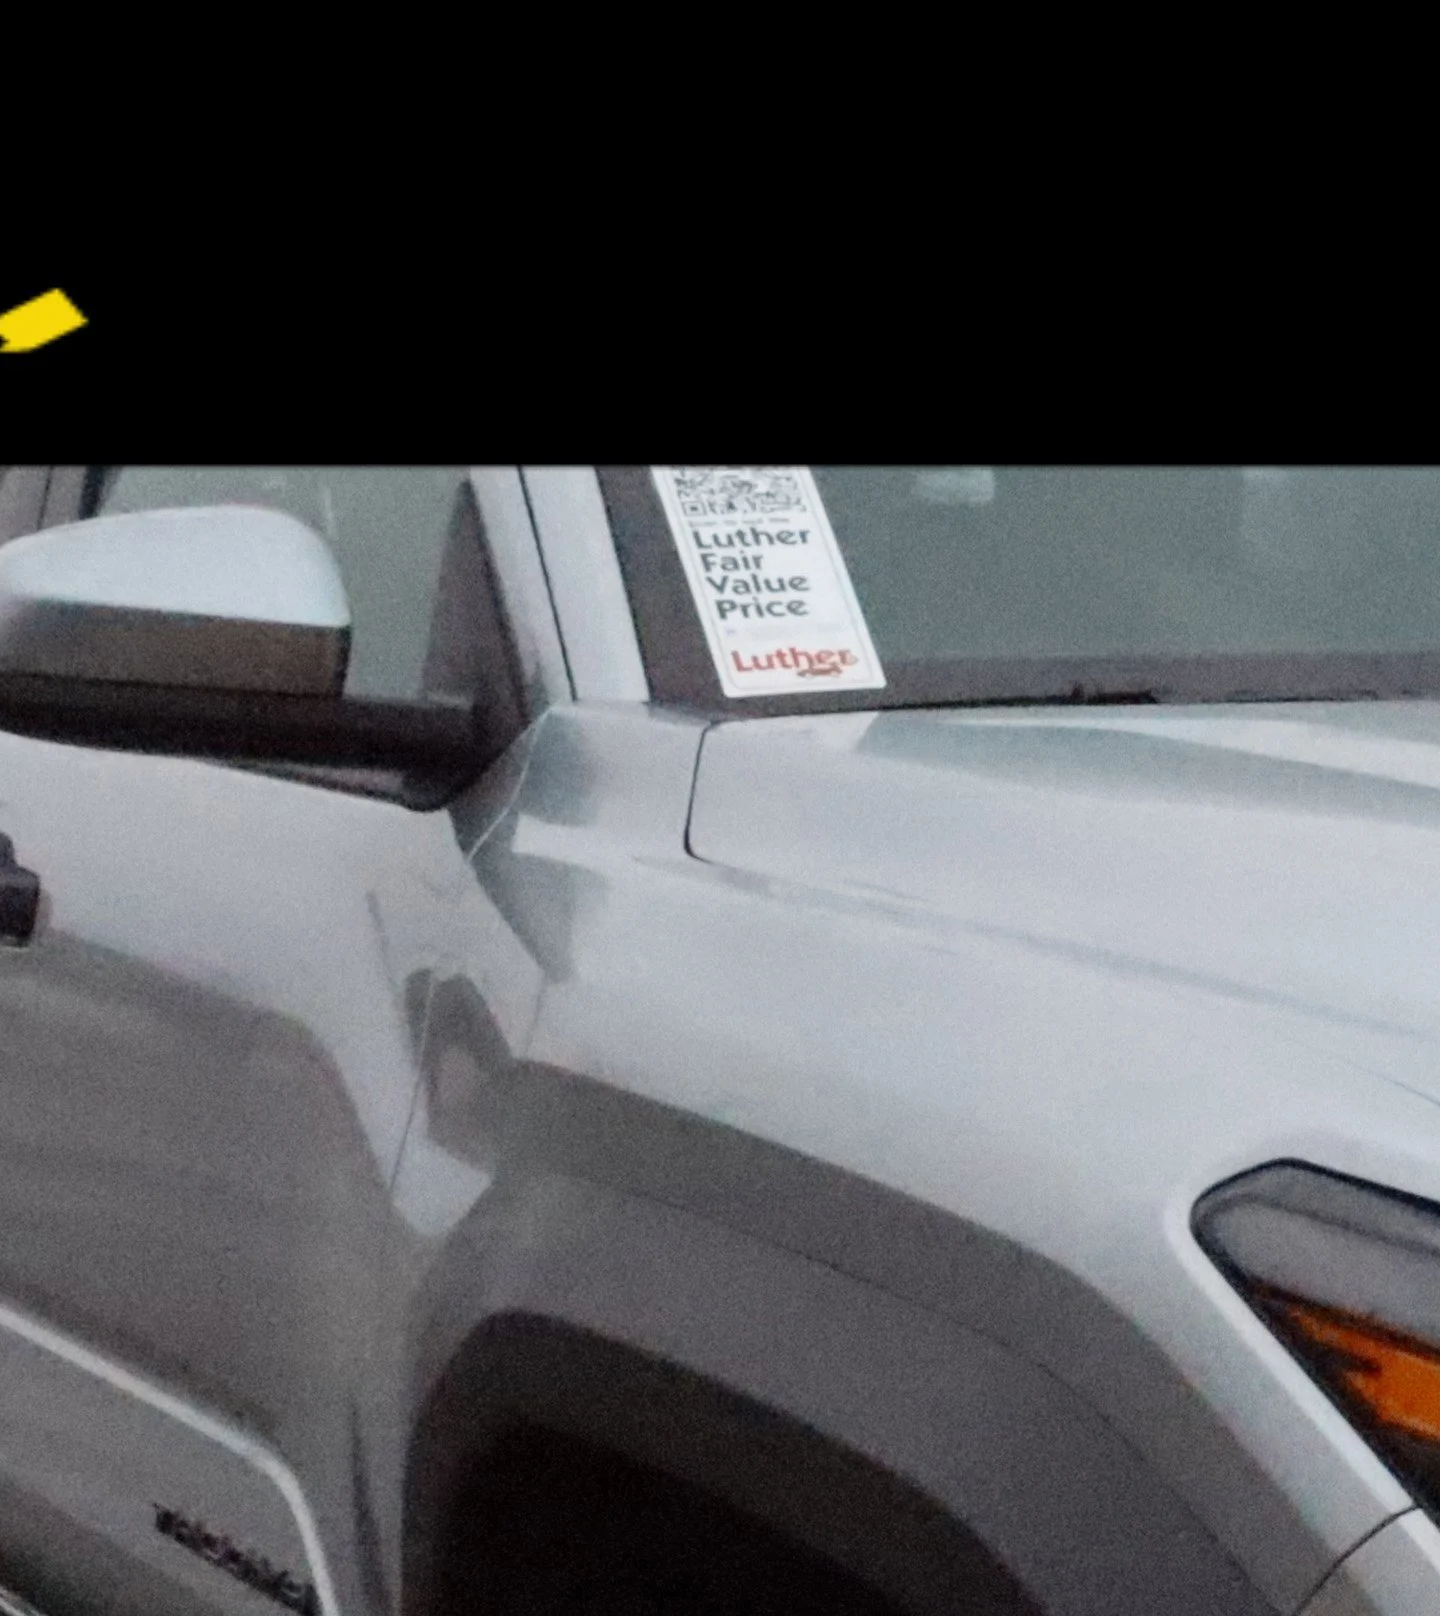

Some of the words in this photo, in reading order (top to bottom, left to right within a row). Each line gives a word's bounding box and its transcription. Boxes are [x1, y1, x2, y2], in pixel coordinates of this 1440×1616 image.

[693, 527, 811, 550] Luther
[700, 551, 764, 573] Fair
[705, 573, 810, 596] Value
[715, 597, 809, 620] Price
[731, 646, 855, 672] Luther
